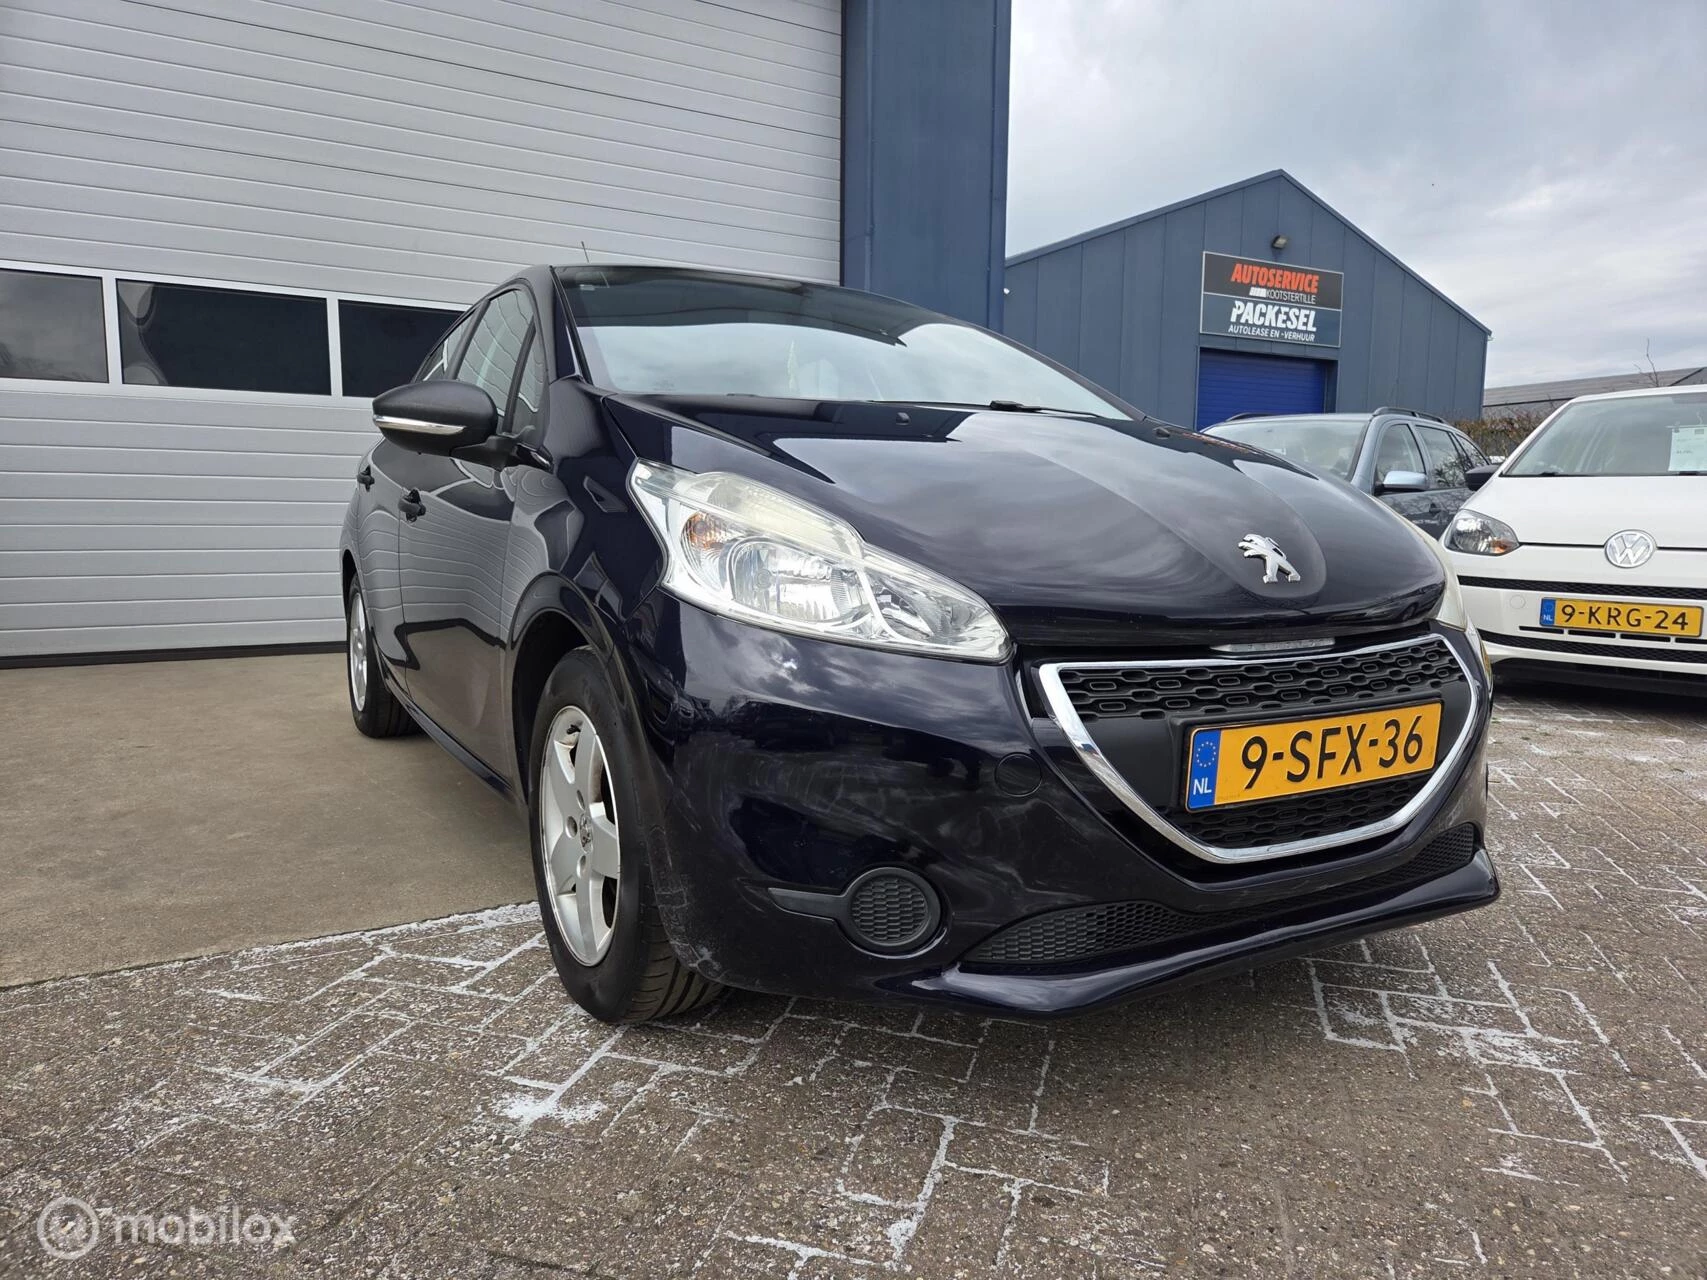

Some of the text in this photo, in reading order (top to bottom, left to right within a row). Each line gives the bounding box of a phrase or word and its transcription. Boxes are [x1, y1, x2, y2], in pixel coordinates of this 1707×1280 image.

[1231, 263, 1319, 294] AUTOSERVICE
[1266, 290, 1316, 305] KOOTSTERTILLE
[1230, 300, 1317, 332] PACKESEL
[1228, 324, 1269, 338] AUTOLEASE
[1270, 329, 1280, 338] EN
[1543, 604, 1688, 631] NL 9-KRG-24
[1193, 715, 1422, 795] NL 9-SFX-36
